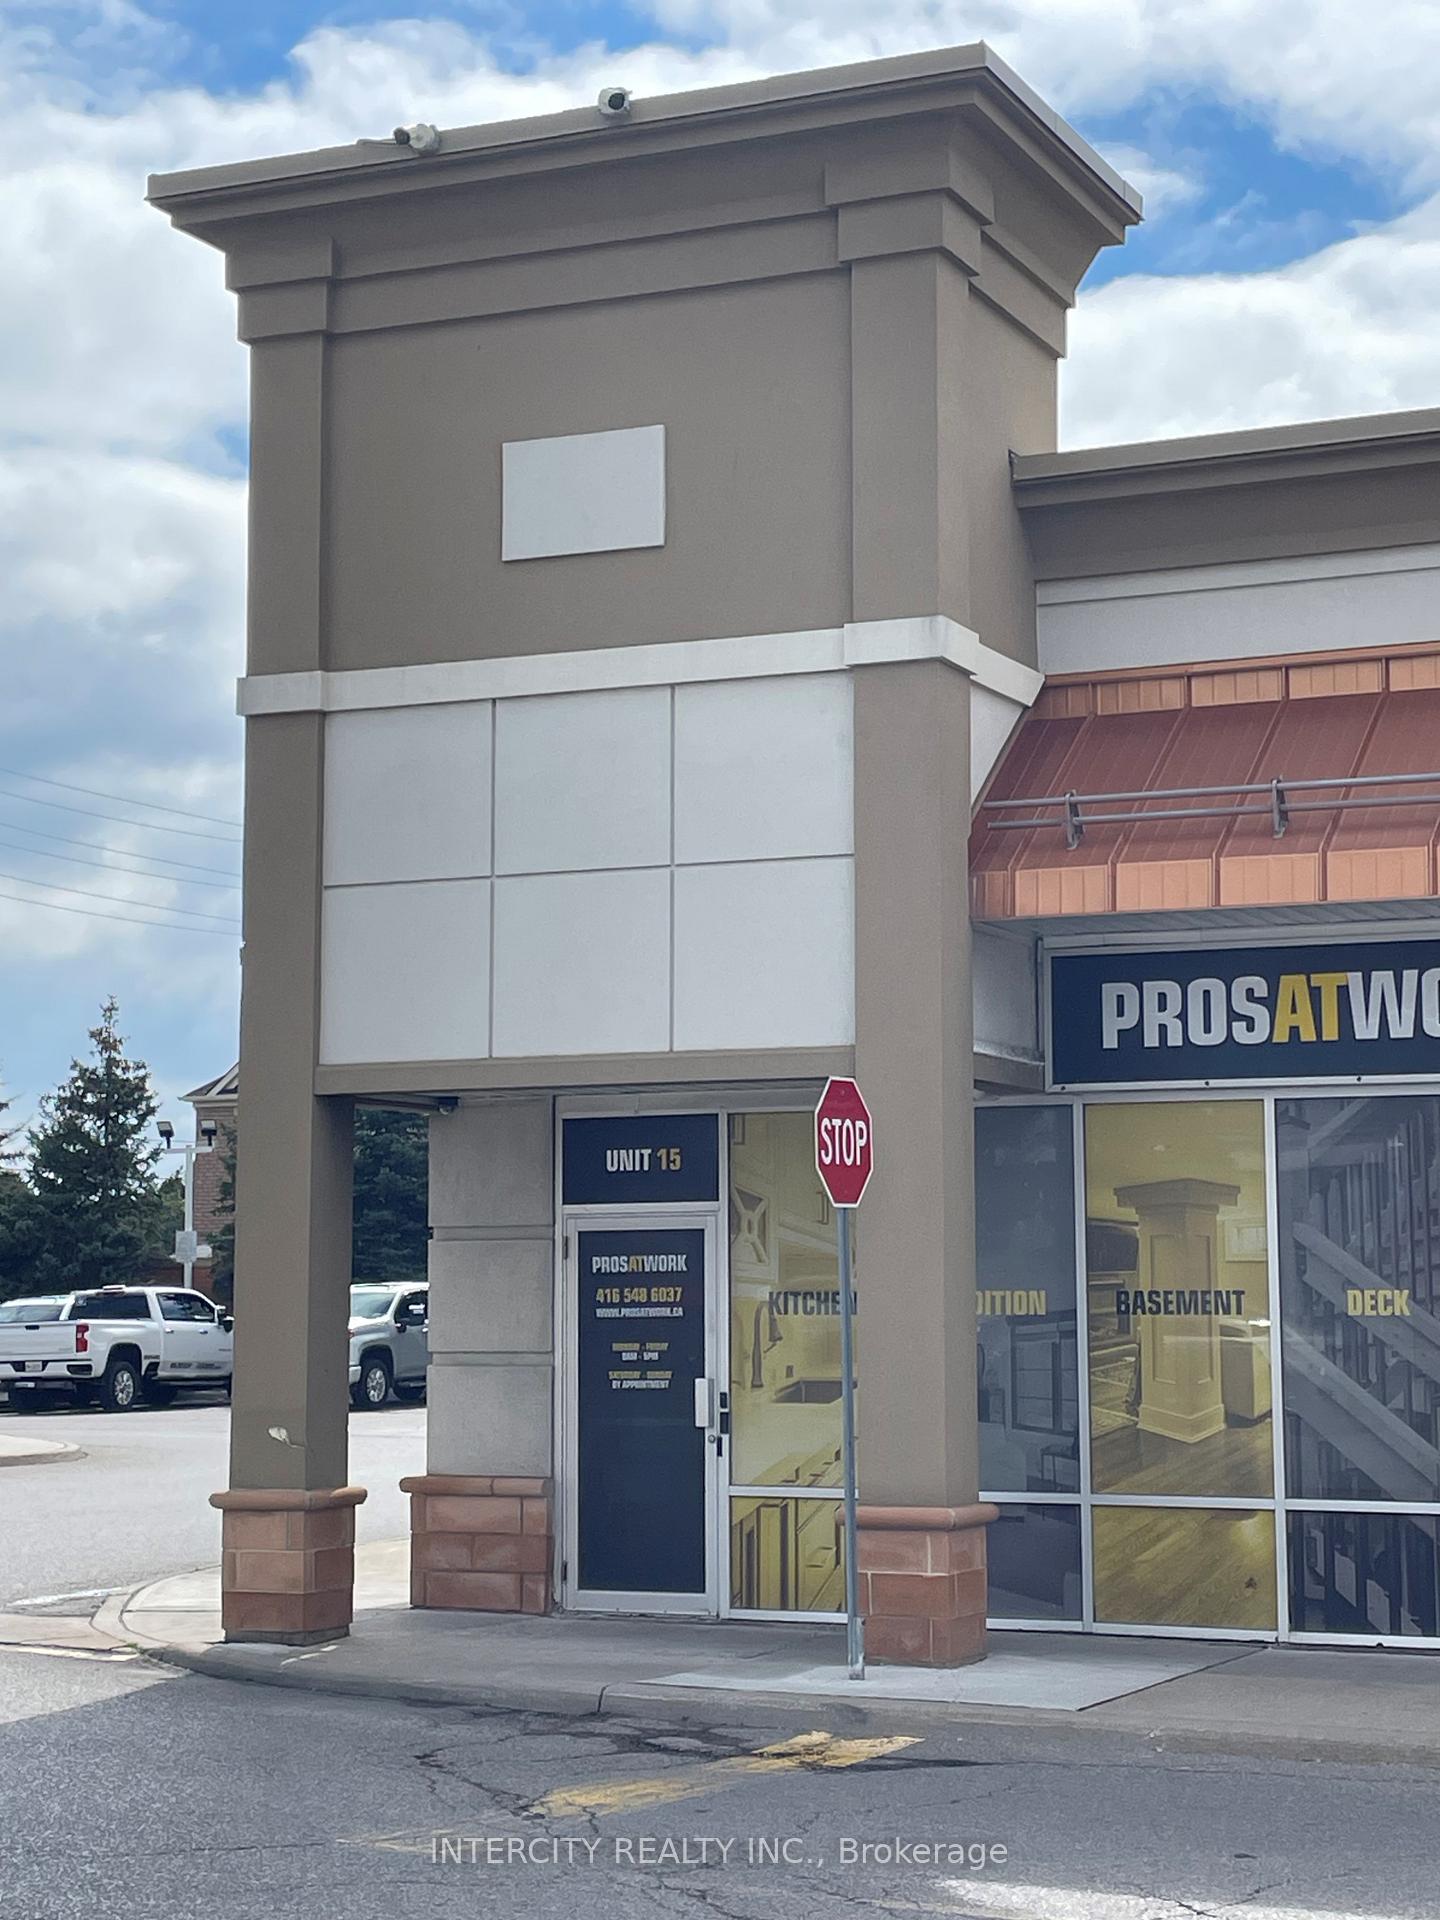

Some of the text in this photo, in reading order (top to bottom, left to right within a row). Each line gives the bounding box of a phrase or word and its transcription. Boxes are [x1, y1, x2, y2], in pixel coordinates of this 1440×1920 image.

[819, 1117, 868, 1166] STOP
[605, 1148, 682, 1172] UNIT 15
[591, 1254, 688, 1274] PROSATWORK
[596, 1288, 620, 1304] 416
[651, 1287, 683, 1303] 6037
[1116, 1289, 1246, 1317] BASEMENT
[1346, 1288, 1411, 1316] DECK
